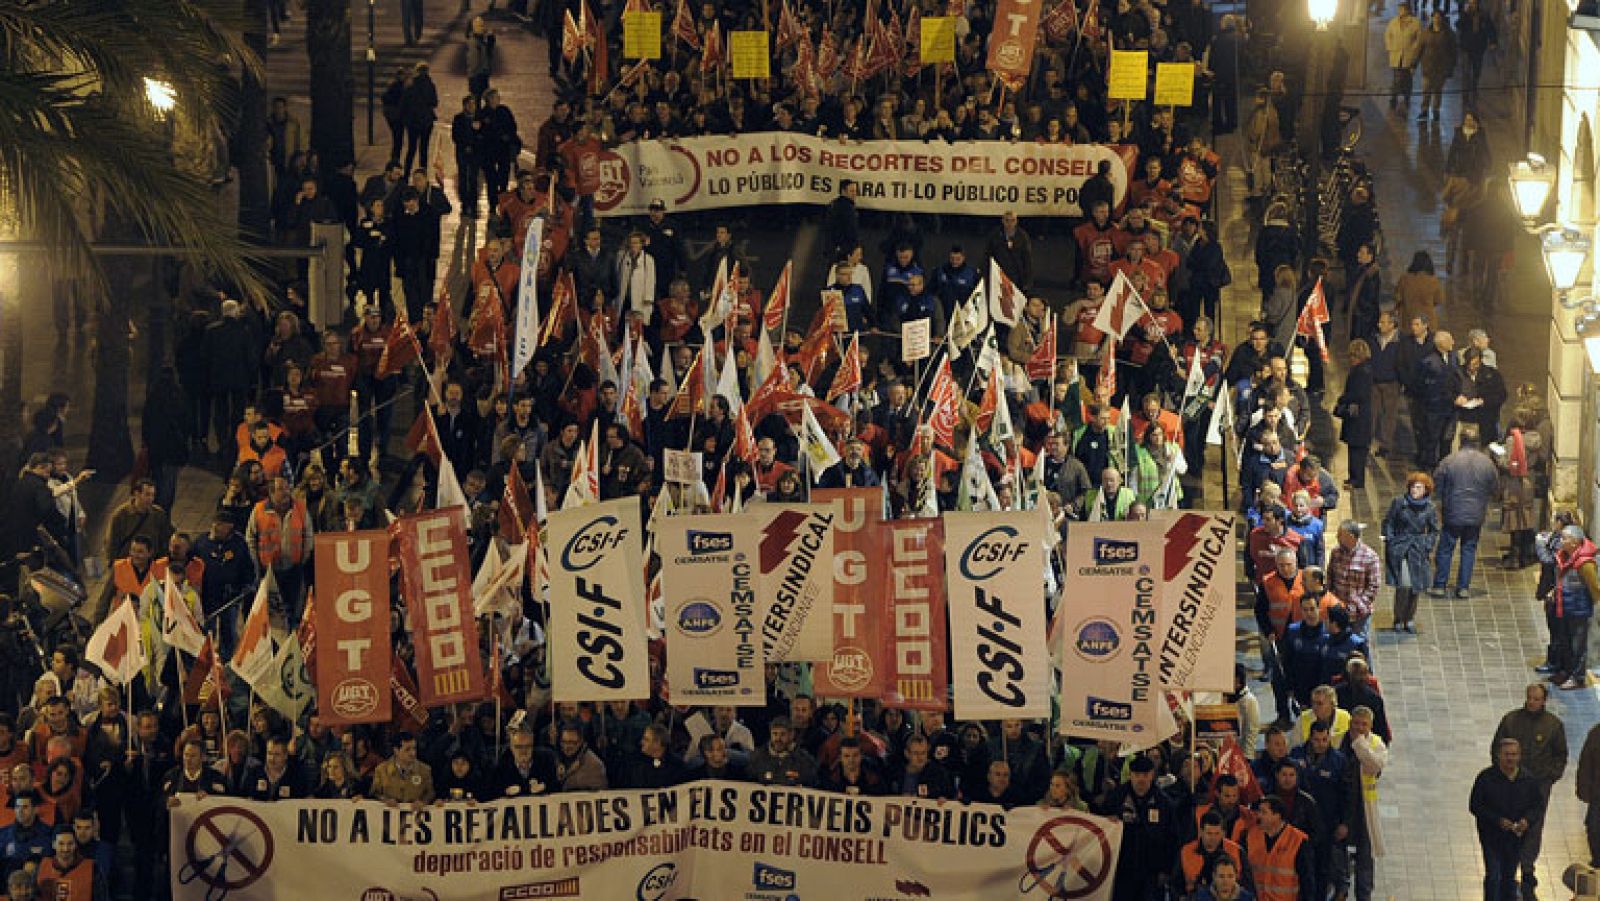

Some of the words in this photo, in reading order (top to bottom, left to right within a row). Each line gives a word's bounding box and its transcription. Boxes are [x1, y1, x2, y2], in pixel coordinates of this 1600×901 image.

[706, 149, 740, 168] NO
[748, 147, 763, 165] A
[770, 143, 811, 163] LOS
[819, 150, 943, 174] RECORTES
[951, 156, 996, 174] DEL
[1004, 157, 1098, 176] CONSEL
[708, 178, 729, 196] LO
[736, 171, 804, 193] PÚBLICO
[811, 175, 831, 193] ES
[942, 180, 1019, 203] PÚBLICO
[1026, 186, 1047, 203] ES
[693, 535, 732, 550] fses
[832, 497, 867, 639] UGT
[1099, 544, 1137, 557] fses
[416, 516, 467, 670] CCOO
[762, 511, 834, 661] NTERSINDICAL
[1078, 567, 1134, 577] CEMSATSE
[334, 539, 372, 672] UGT
[730, 562, 755, 669] CEMSATSE
[892, 526, 932, 676] CCOO
[1130, 577, 1156, 702] CEMSATSE
[1091, 701, 1130, 717] fses
[297, 808, 338, 845] NO
[349, 808, 370, 844] A
[381, 808, 433, 846] LES
[444, 796, 632, 846] RETALLADES
[640, 789, 678, 827] EN
[688, 786, 738, 821] ELS
[749, 789, 873, 834] SERVEIS
[882, 800, 1006, 848] PÚBLICS
[413, 843, 524, 877] depuració
[530, 847, 556, 871] de
[563, 824, 733, 868] responsabilitats
[740, 831, 766, 855] en
[772, 831, 792, 857] el
[798, 833, 888, 866] CONSELL
[503, 884, 554, 898] CCOO
[758, 868, 792, 888] fses
